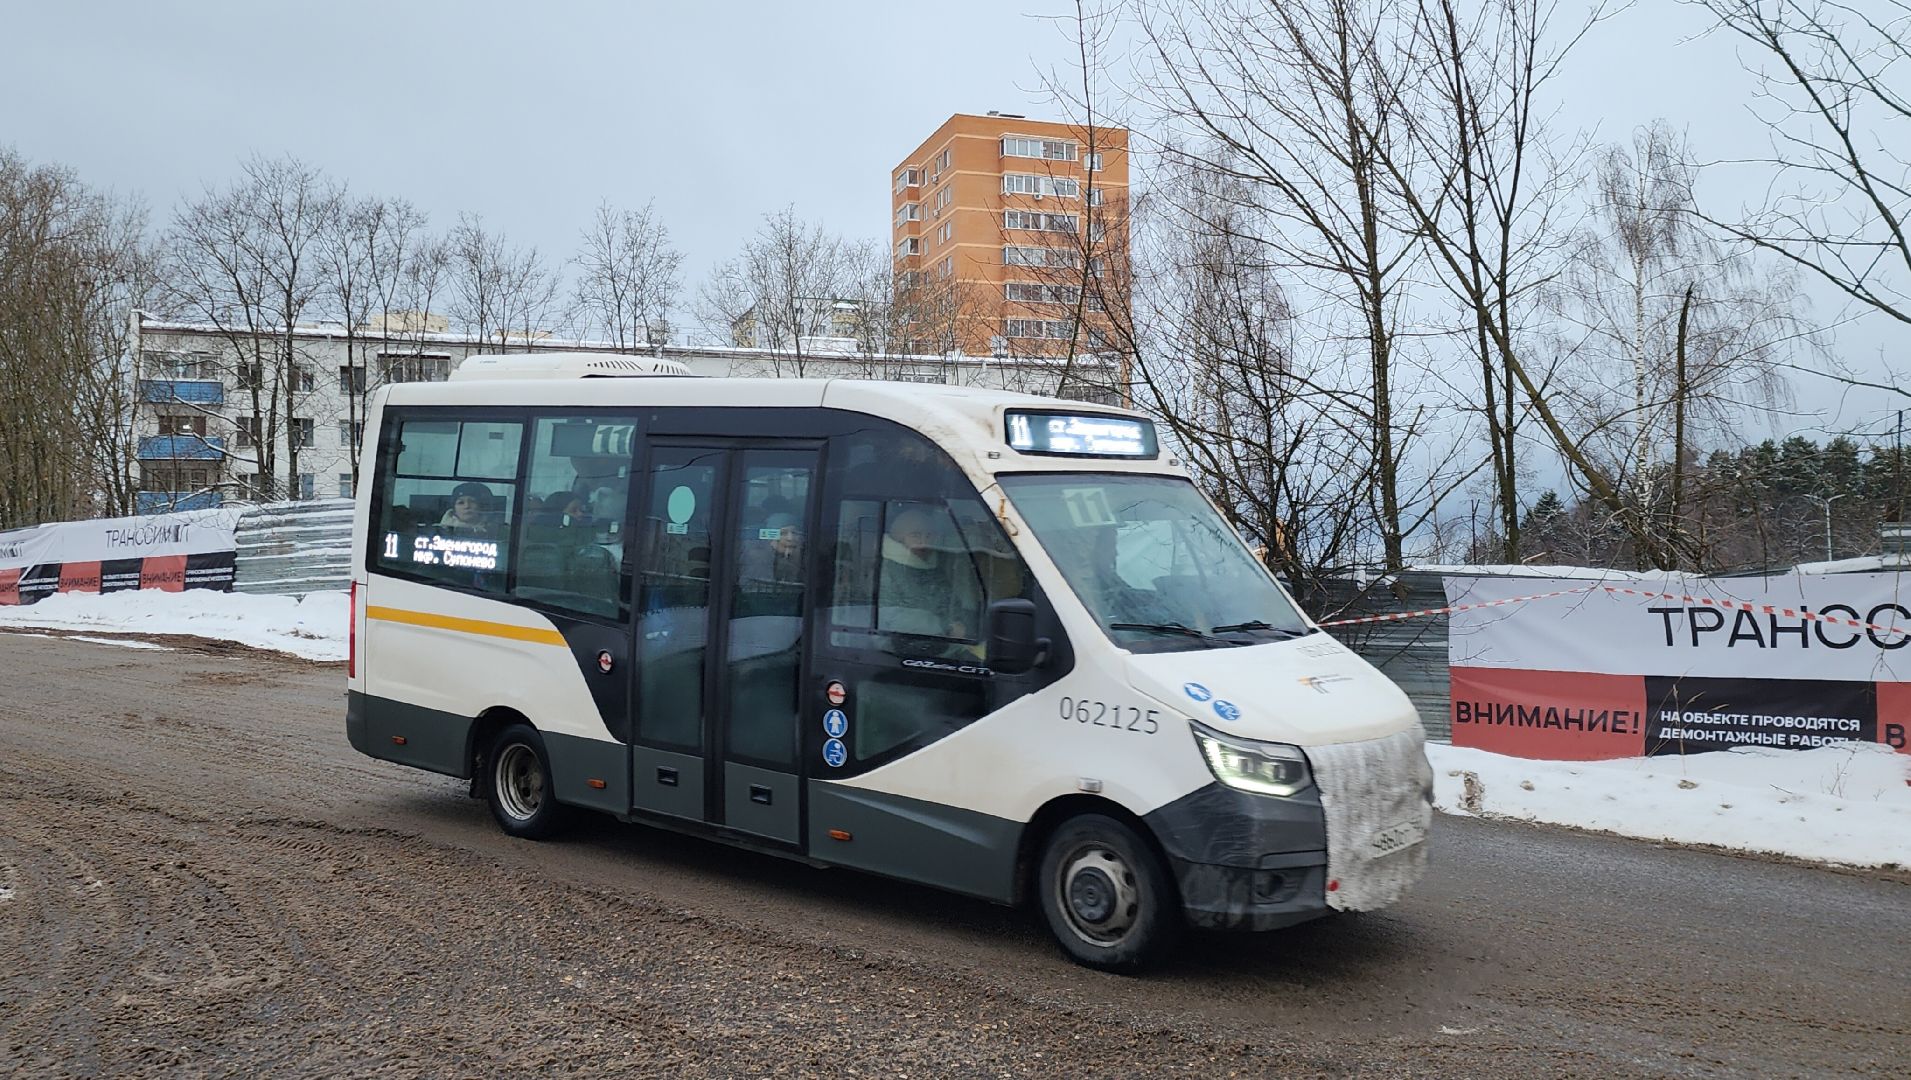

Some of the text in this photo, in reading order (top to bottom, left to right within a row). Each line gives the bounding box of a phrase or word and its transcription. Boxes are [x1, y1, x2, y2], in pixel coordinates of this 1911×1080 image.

[596, 426, 630, 454] 11
[1010, 415, 1033, 446] 11
[1066, 490, 1114, 523] 11
[384, 533, 398, 557] 11
[1647, 604, 1911, 649] ТРАНСС
[1060, 696, 1159, 735] 062125
[1456, 701, 1640, 734] ВНИМАНИЕ!
[1660, 710, 1861, 732] НА ОБЪЕКТЕ ПРОВОДЯТСЯ
[1659, 728, 1786, 746] ДЕМОНТАЖНЫЕ
